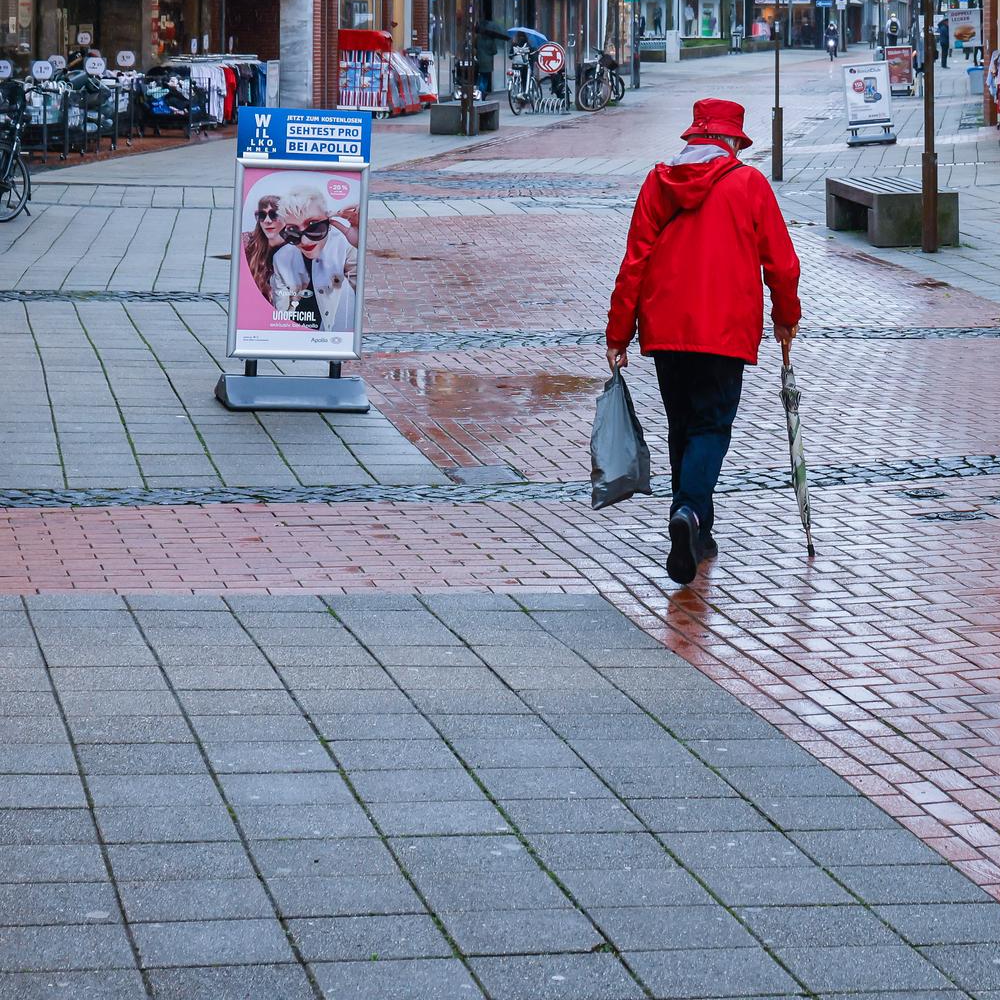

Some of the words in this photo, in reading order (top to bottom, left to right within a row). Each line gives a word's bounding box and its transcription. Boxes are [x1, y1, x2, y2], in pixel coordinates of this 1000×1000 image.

[289, 126, 336, 137] SEHTEST
[338, 127, 359, 138] PRO
[288, 141, 308, 152] BEI
[311, 142, 358, 154] APOLLO
[272, 310, 316, 322] UNOFFICIAL
[310, 337, 329, 345] Apollo
